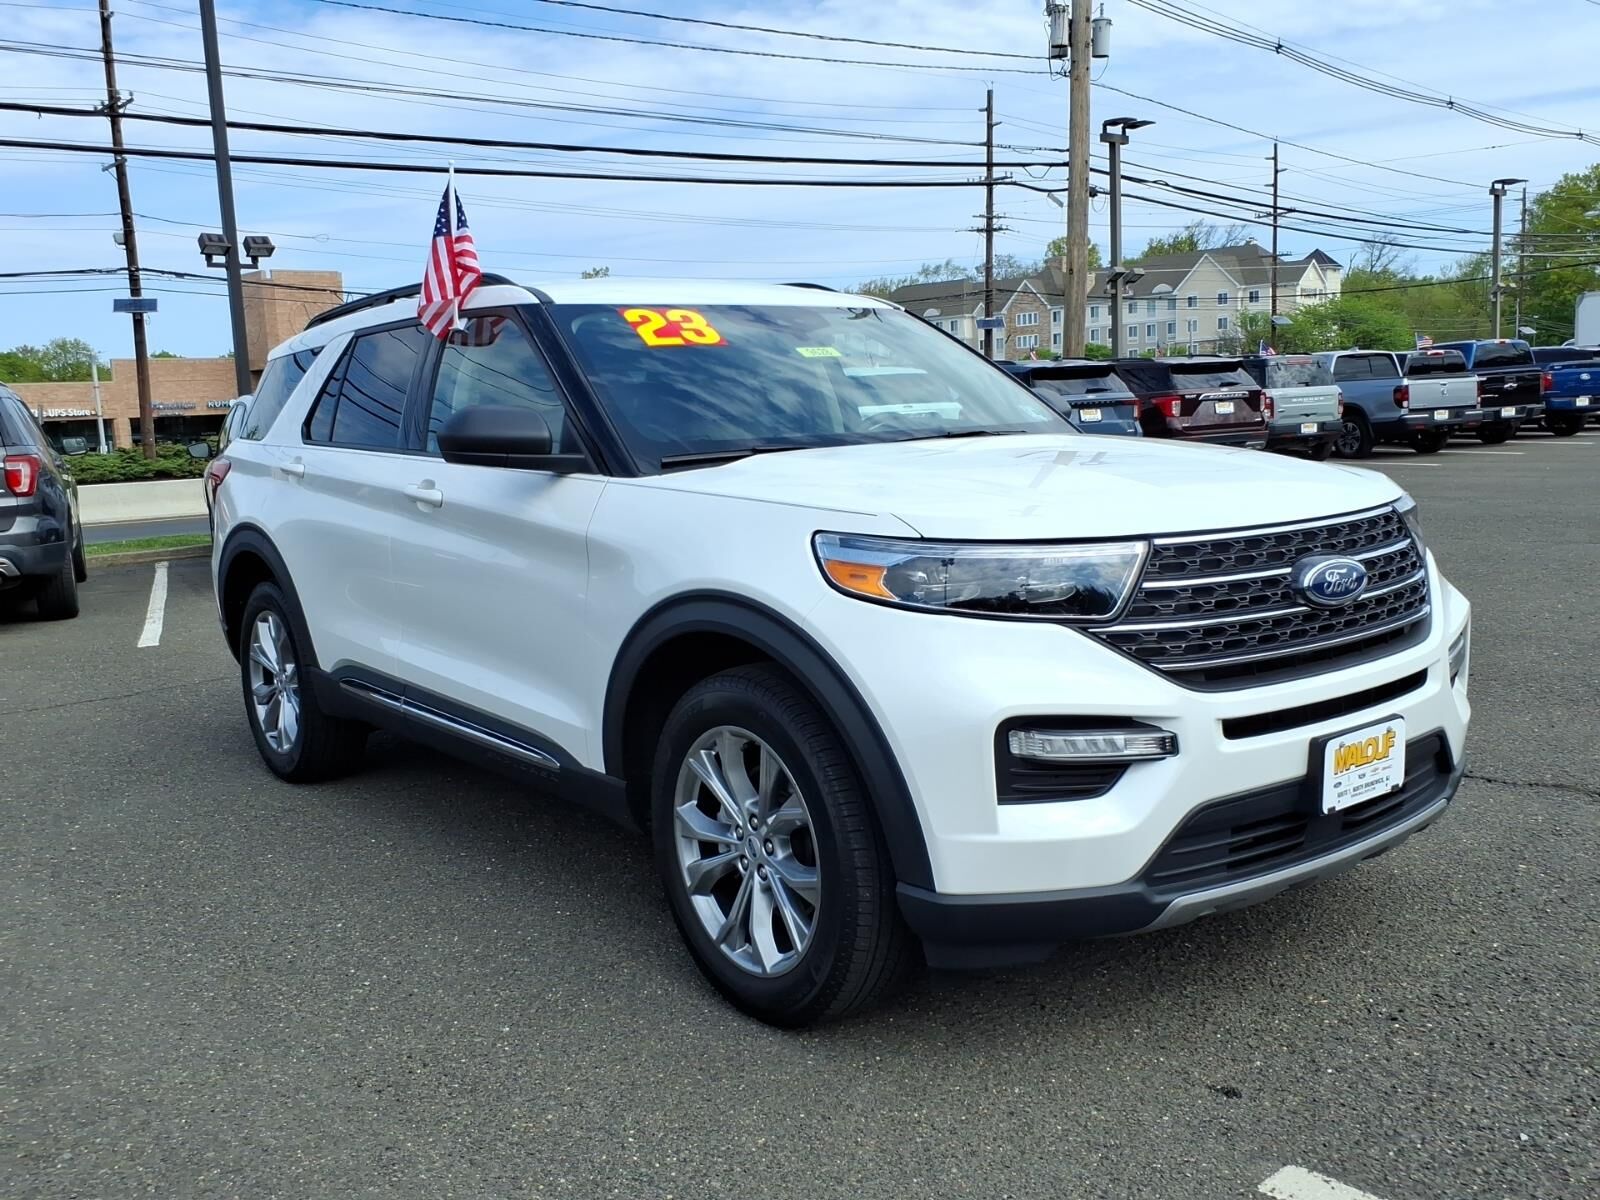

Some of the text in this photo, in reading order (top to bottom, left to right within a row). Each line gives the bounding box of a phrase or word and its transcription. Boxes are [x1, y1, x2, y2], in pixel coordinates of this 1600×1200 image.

[623, 308, 721, 346] 23
[48, 408, 66, 417] UPS
[68, 408, 91, 417] Store
[1323, 567, 1358, 595] Ford
[1333, 730, 1397, 776] MALOUF
